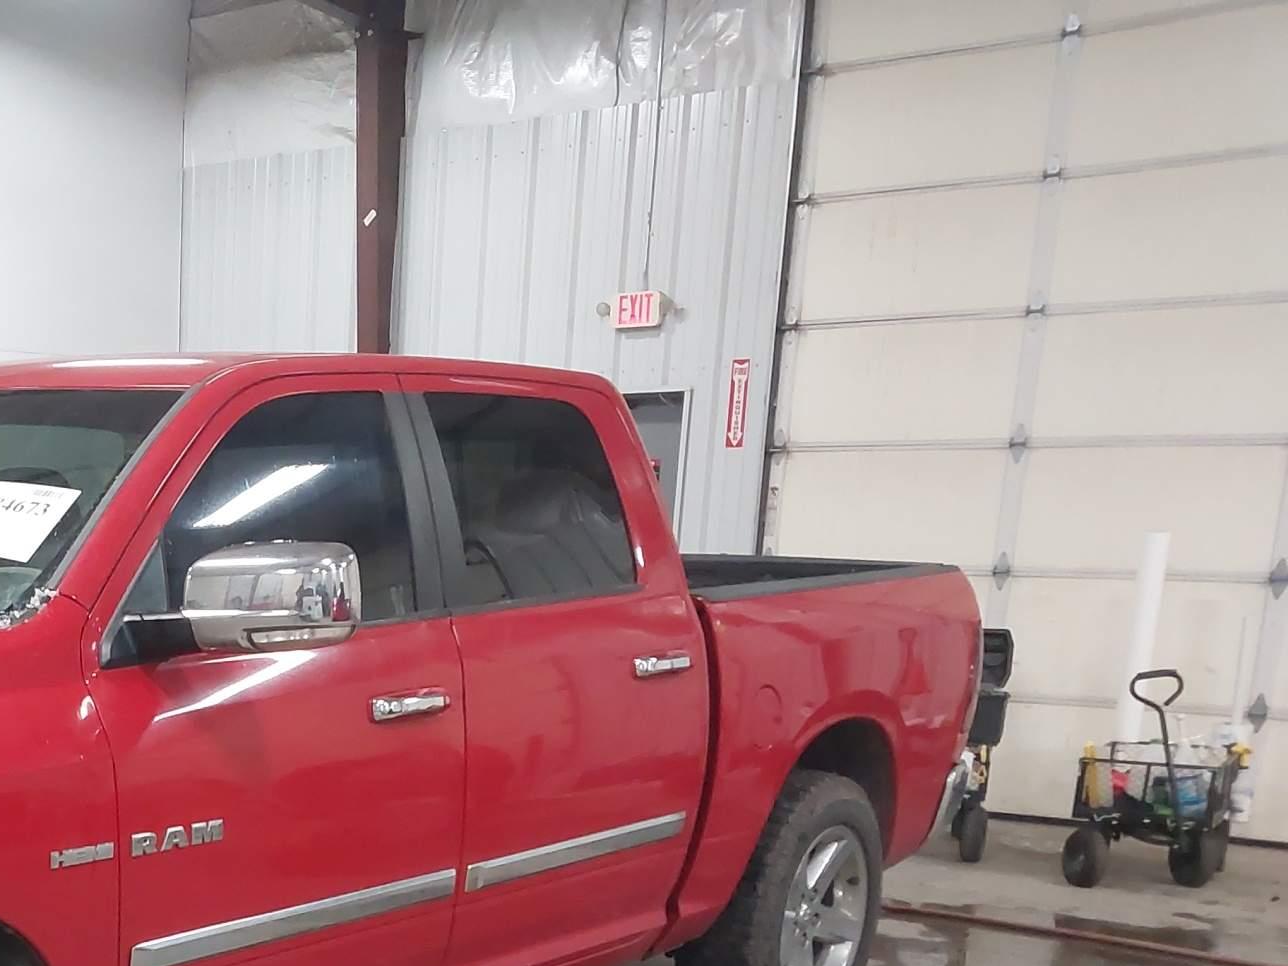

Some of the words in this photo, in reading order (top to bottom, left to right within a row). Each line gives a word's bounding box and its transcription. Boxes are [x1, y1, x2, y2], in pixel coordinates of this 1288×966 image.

[618, 293, 654, 325] EXIT
[130, 818, 224, 857] RAM
[49, 842, 115, 870] HEMI
